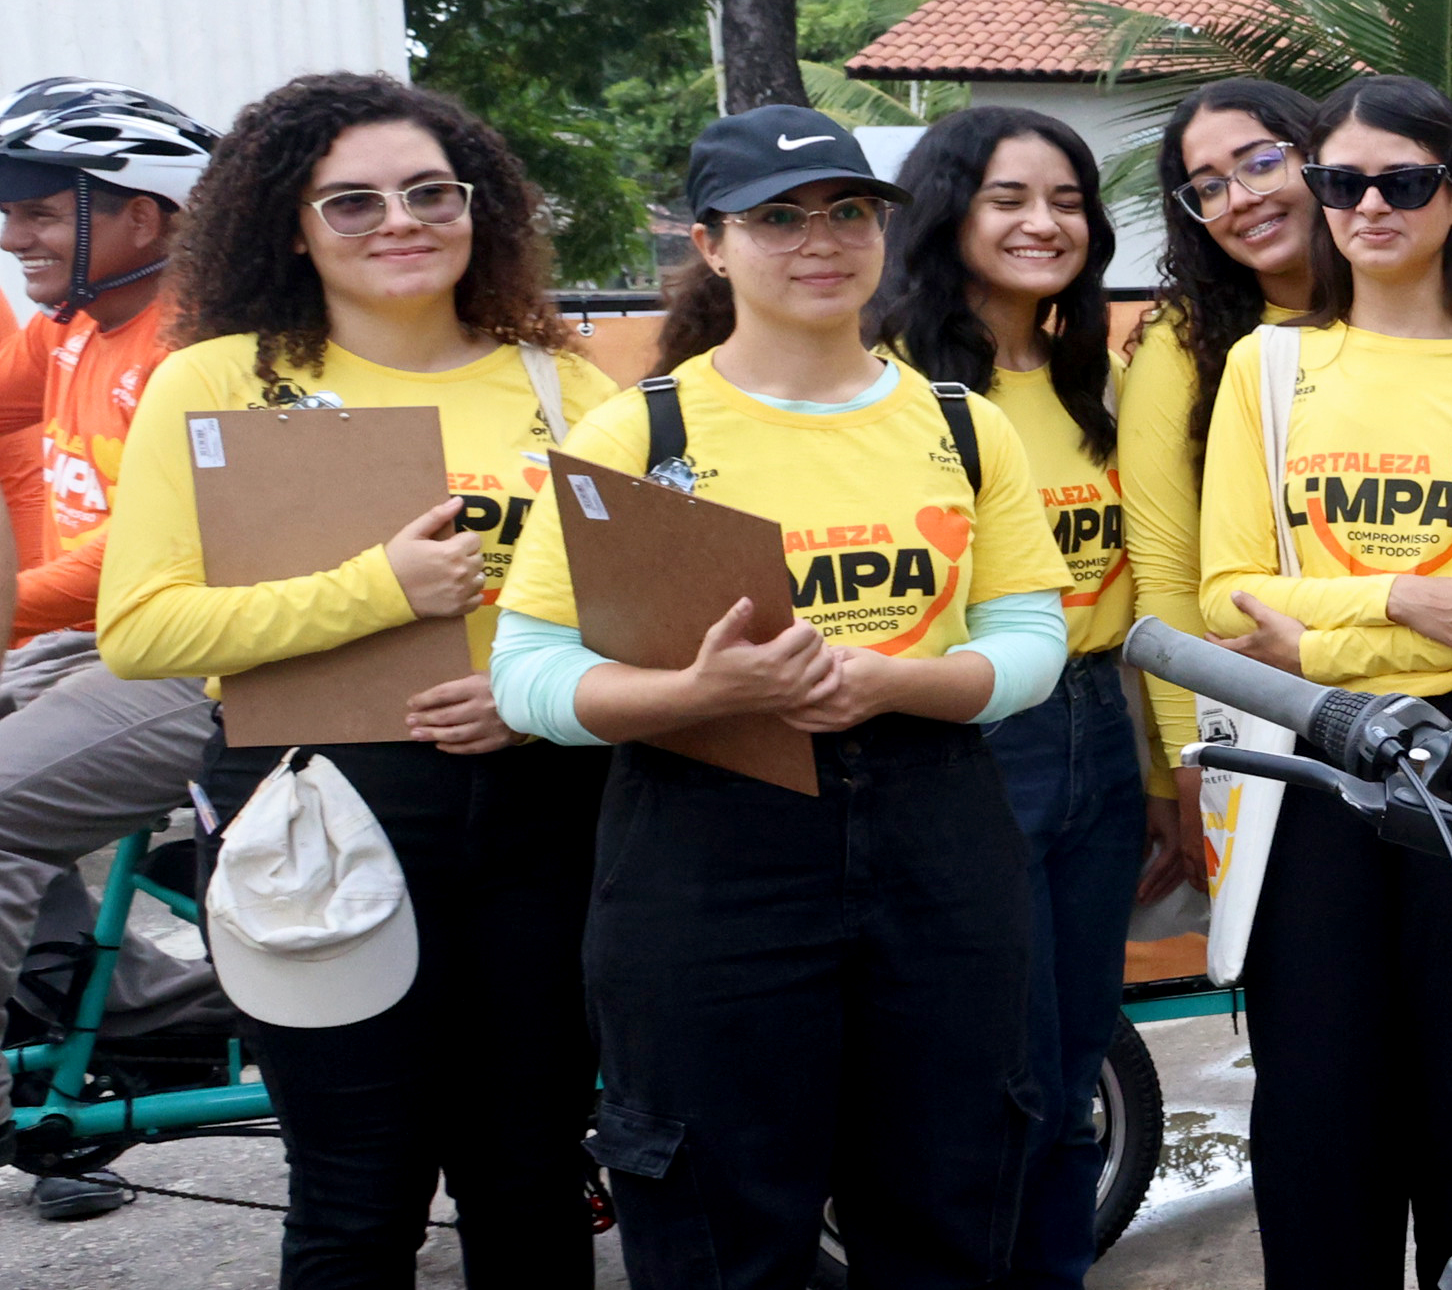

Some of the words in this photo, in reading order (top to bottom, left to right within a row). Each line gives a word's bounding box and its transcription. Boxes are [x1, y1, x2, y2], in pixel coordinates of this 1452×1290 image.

[1284, 451, 1431, 480] FORTALEZA
[1041, 483, 1102, 507] ALEZA
[784, 523, 894, 554] ALEZA
[1053, 504, 1122, 554] MPA
[1347, 531, 1440, 543] COMPROMISSO
[1361, 544, 1374, 554] DE
[1378, 546, 1421, 557] TODOS
[786, 548, 936, 609] MPA
[824, 624, 843, 637] DE
[847, 619, 899, 634] TODOS
